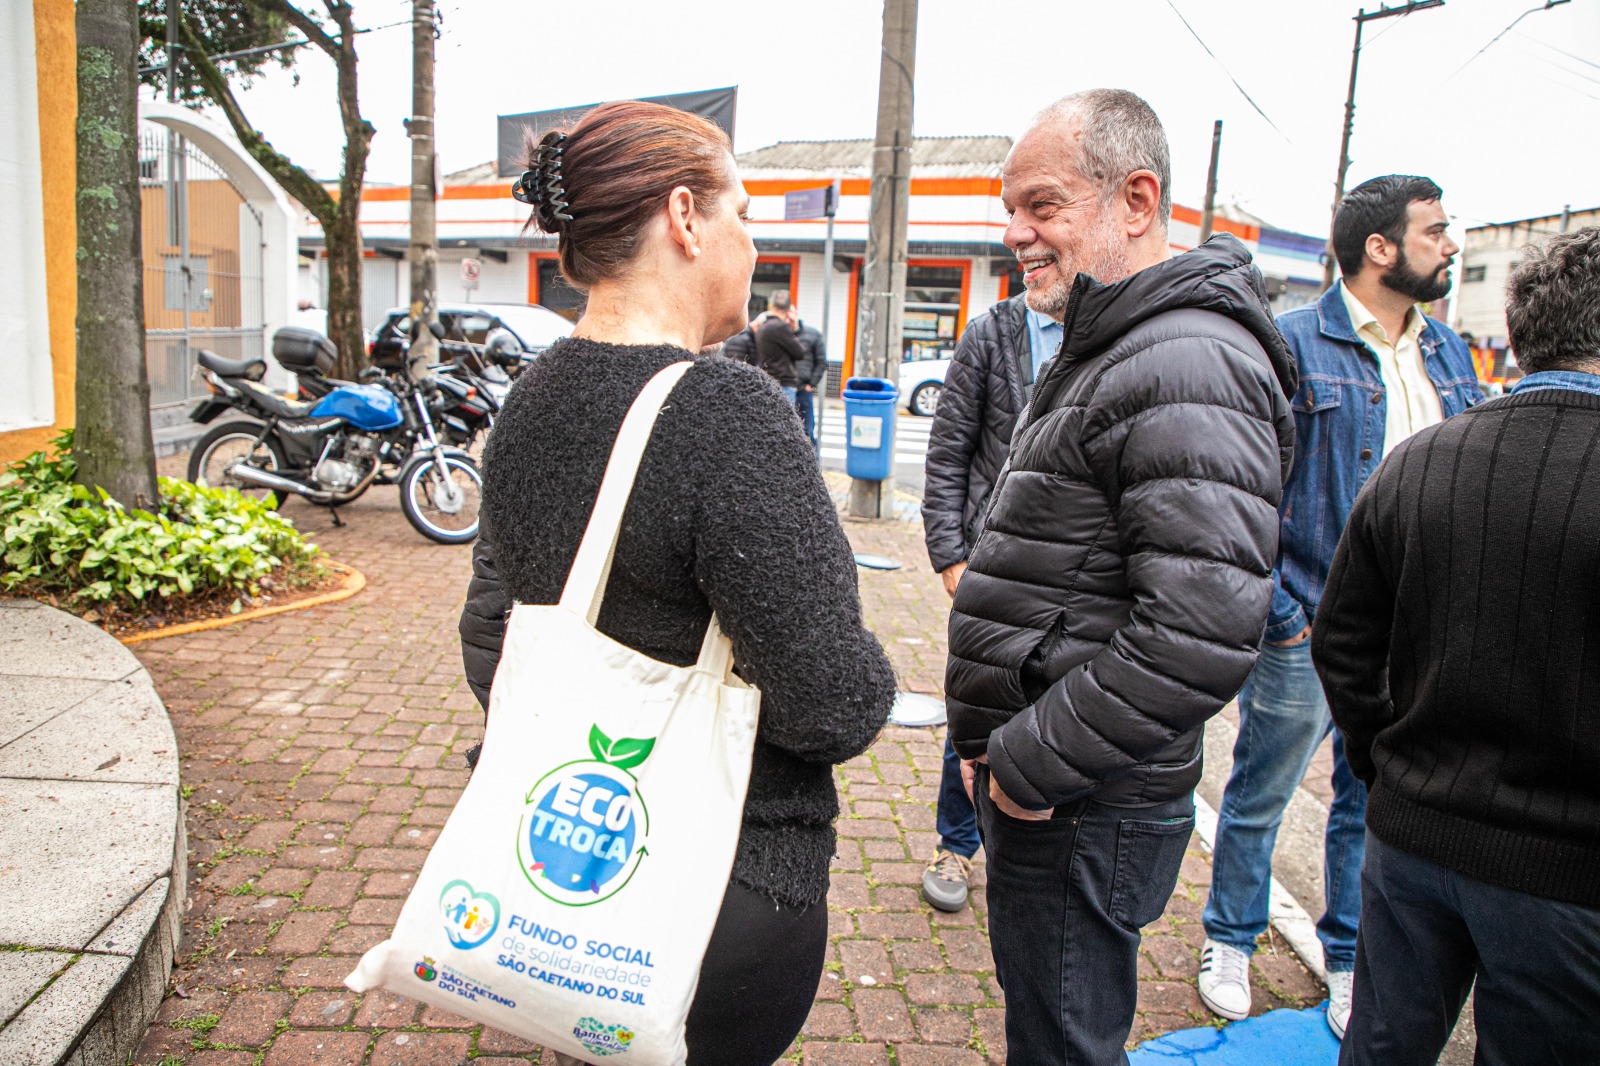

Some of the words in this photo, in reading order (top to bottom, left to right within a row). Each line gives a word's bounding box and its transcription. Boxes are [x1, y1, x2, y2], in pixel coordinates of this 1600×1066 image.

[551, 776, 632, 832] ECO
[533, 808, 627, 864] TROCA
[502, 935, 526, 955] de
[528, 947, 651, 988] solidariedade
[508, 914, 578, 950] FUNDO
[584, 940, 655, 968] SOCIAL
[438, 981, 455, 993] DO
[456, 988, 478, 1002] SUL
[440, 971, 463, 987] SÃO
[464, 982, 517, 1009] CAETANO
[496, 954, 526, 973] SÃO
[528, 966, 594, 995] CAETANO
[596, 985, 618, 1000] DO
[620, 990, 646, 1006] SUL
[573, 1027, 611, 1042] Banco
